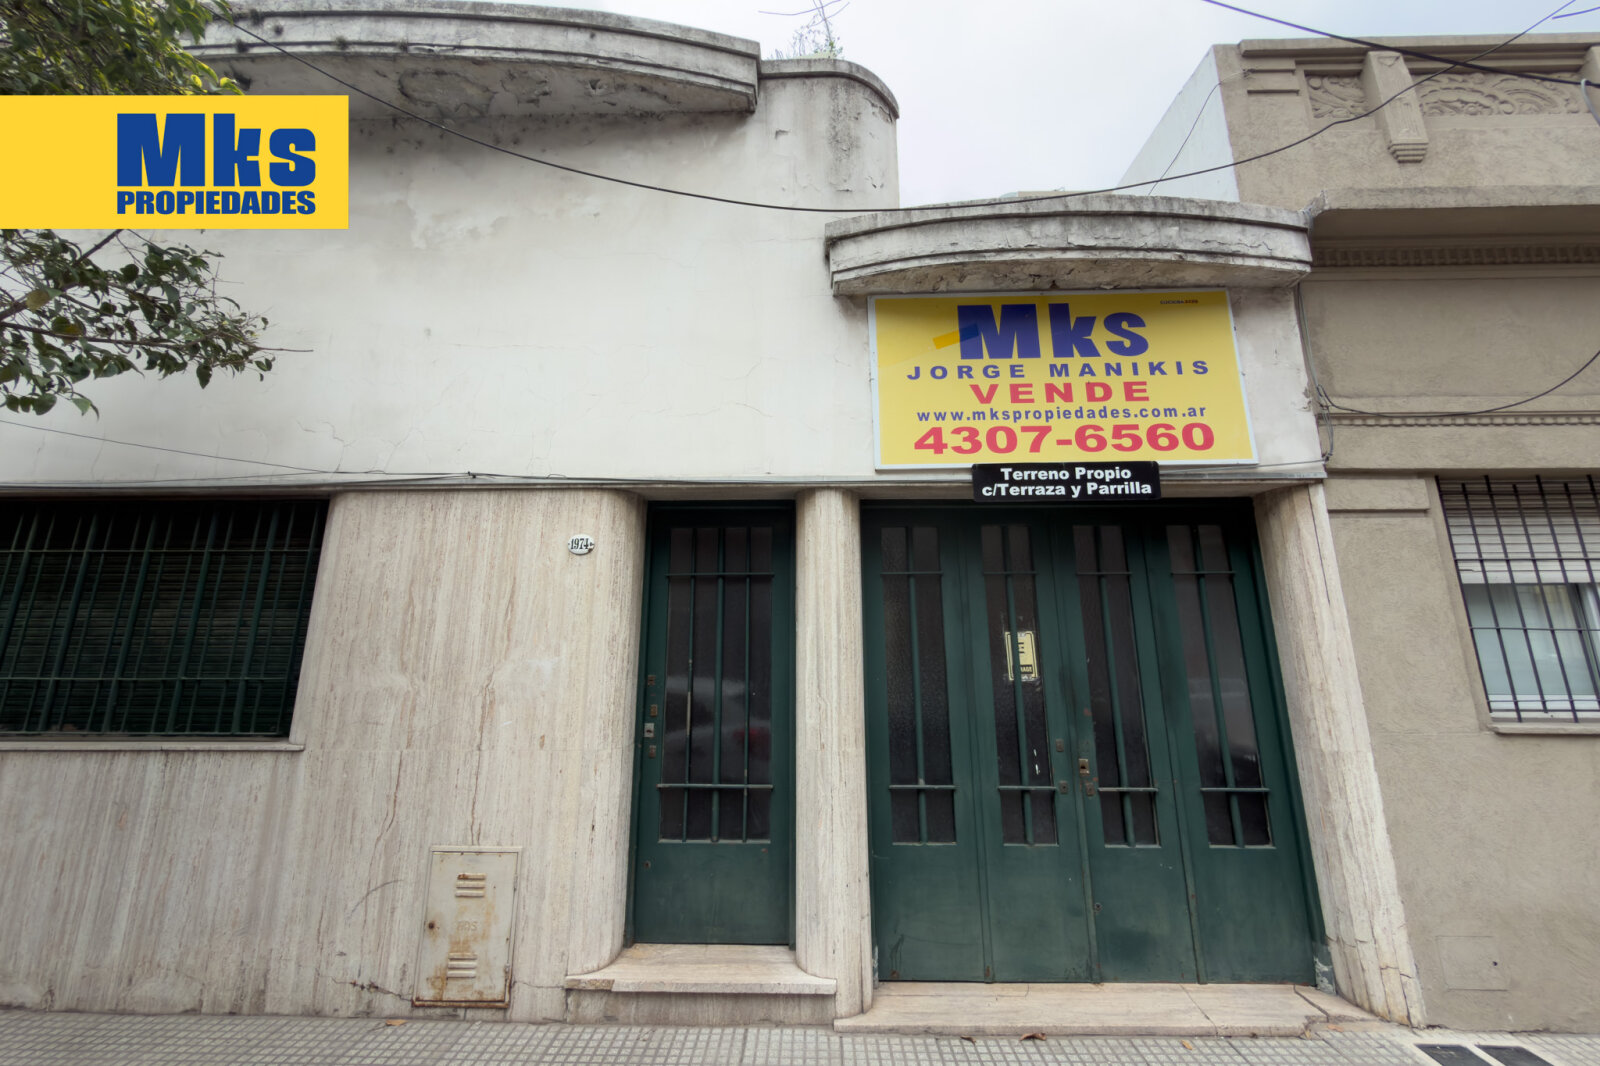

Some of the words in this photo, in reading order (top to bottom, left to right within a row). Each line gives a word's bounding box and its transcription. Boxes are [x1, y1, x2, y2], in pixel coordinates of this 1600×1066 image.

[957, 303, 1149, 359] Mks
[907, 364, 1025, 380] JORGE
[1049, 360, 1209, 377] MANIKIS
[969, 381, 1150, 404] VENDE
[917, 405, 1206, 423] www.mkspropiedades.com.ar
[914, 422, 1215, 454] 4307-6560
[1000, 468, 1069, 480] Terreno
[1075, 467, 1131, 481] Propio
[982, 484, 1066, 496] c/Terraza
[1071, 486, 1080, 498] y
[1087, 482, 1152, 495] Parrilla
[571, 538, 589, 549] 1974
